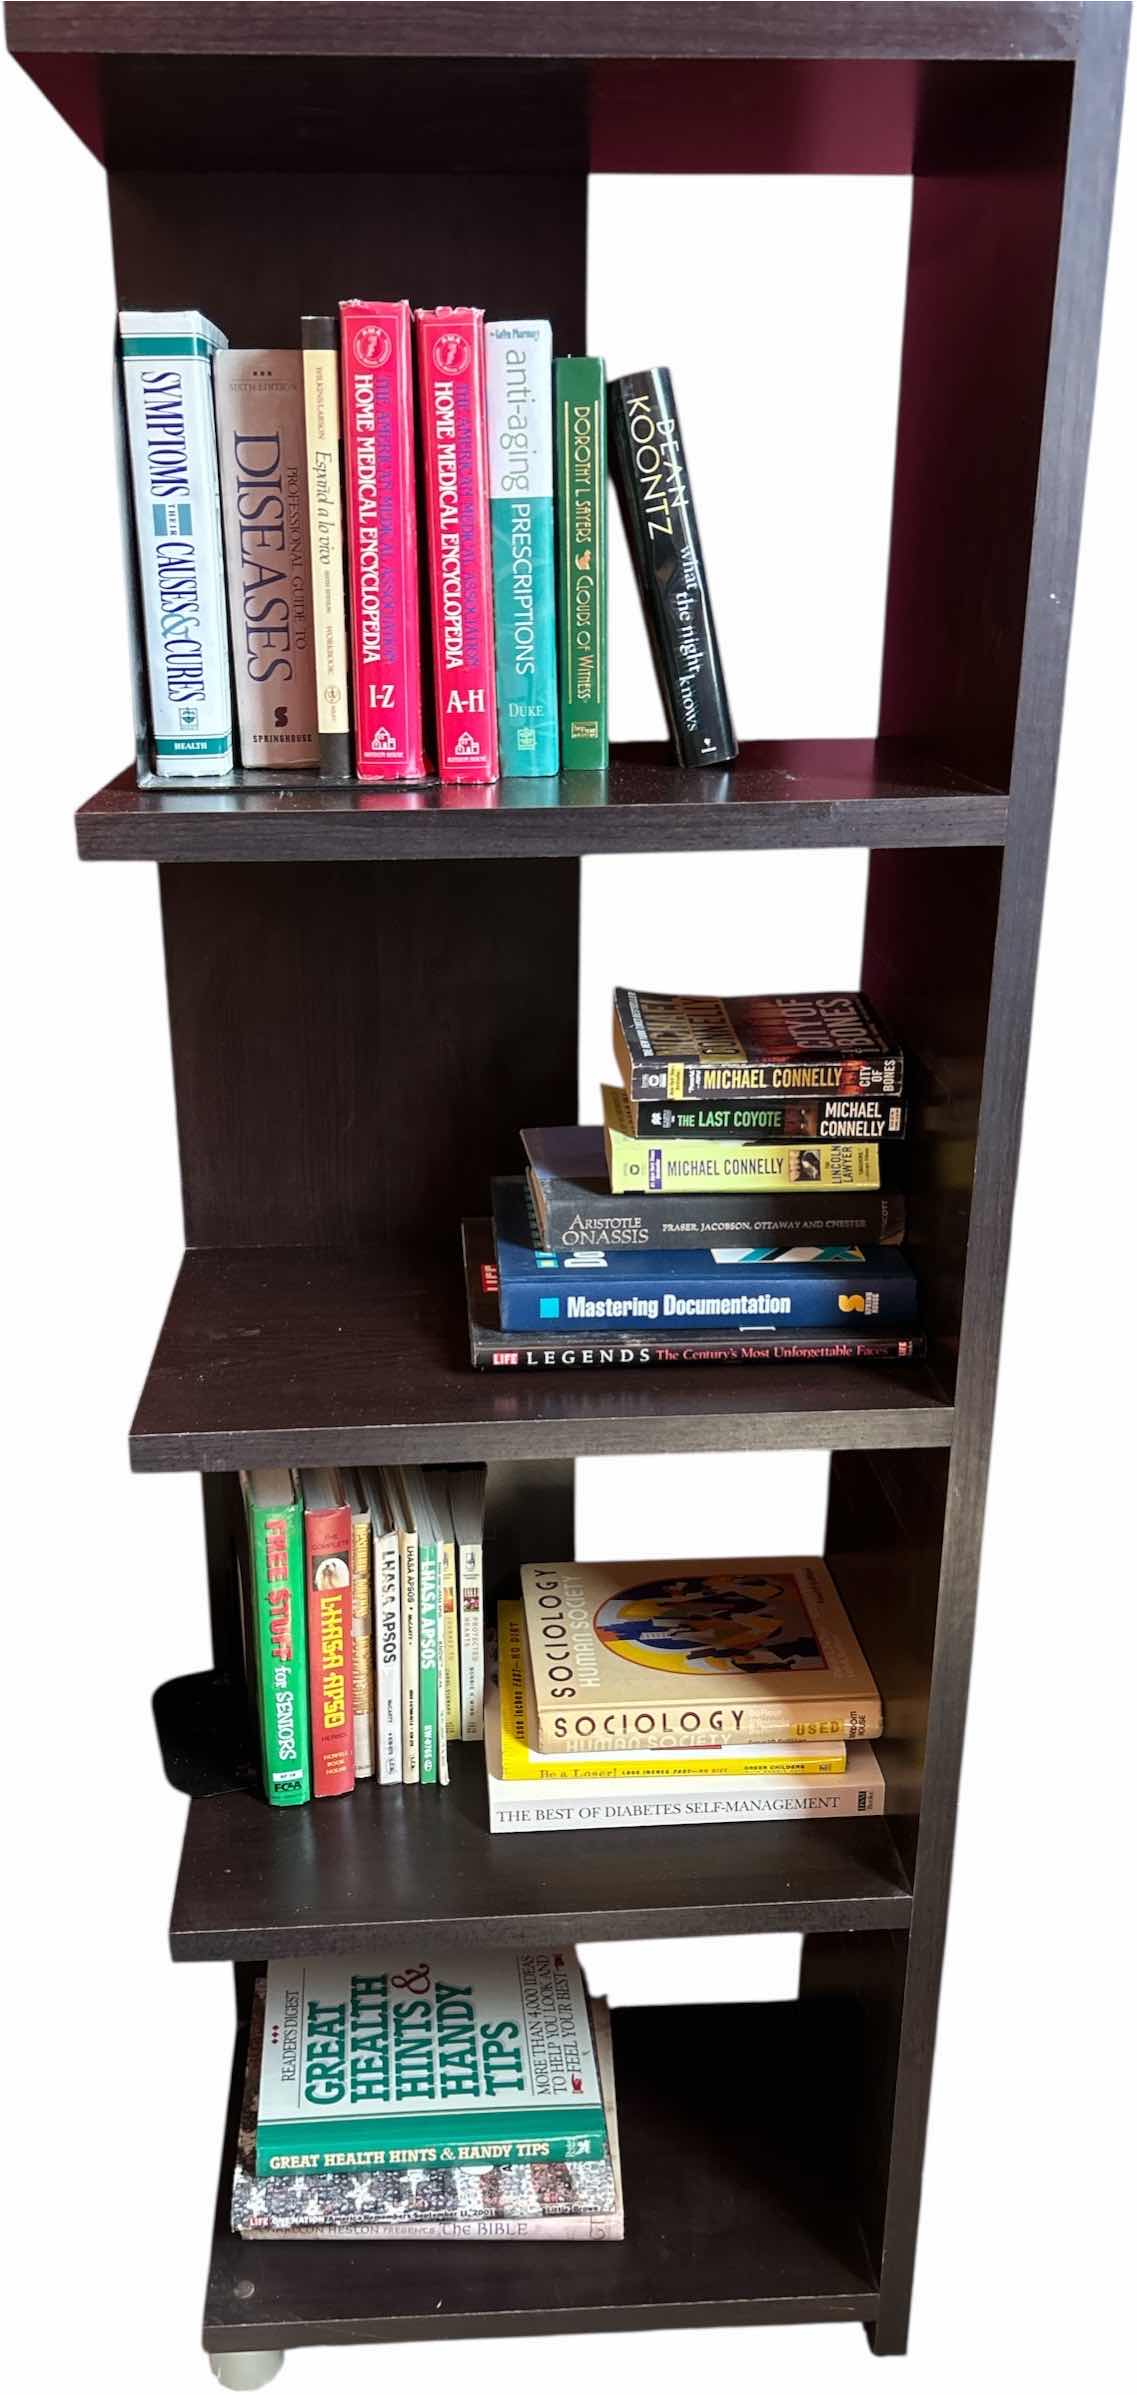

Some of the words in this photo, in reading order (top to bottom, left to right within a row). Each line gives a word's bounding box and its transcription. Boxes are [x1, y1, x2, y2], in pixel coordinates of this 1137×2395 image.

[354, 373, 376, 432] HOME
[434, 381, 456, 439] HOME
[499, 350, 537, 492] anti-aging
[140, 371, 191, 498] SYMPTOMS
[167, 503, 178, 537] THEIR
[575, 406, 591, 484] DOROTHY
[312, 450, 335, 504] Español
[356, 436, 379, 525] MEDICAL
[626, 394, 674, 541] KOONTZ
[656, 418, 691, 510] DEAN
[437, 443, 460, 530] MEDICAL
[286, 466, 304, 569] PROFESSIONAL
[317, 507, 330, 517] a
[317, 520, 336, 534] lo
[575, 500, 592, 544] SAYERS
[233, 431, 294, 683] DISEASES
[318, 536, 336, 565] vivo
[680, 545, 700, 590] what
[291, 576, 308, 624] GUIDE
[359, 526, 381, 665] ENCYCLOPEDIA
[440, 533, 464, 670] ENCYCLOPEDIA
[510, 503, 536, 676] PRESCRIPTIONS
[675, 591, 695, 622] the
[295, 631, 309, 652] TO
[678, 624, 706, 675] night
[368, 684, 396, 708] I-Z
[446, 688, 486, 714] A-H
[678, 674, 698, 732] knows
[784, 1017, 835, 1050] CITY
[815, 998, 874, 1047] BONES
[703, 1068, 768, 1090] MICHAEL
[771, 1067, 843, 1088] CONNELLY
[858, 1066, 872, 1088] CITY
[871, 1070, 882, 1083] OF
[882, 1059, 896, 1092] BONES
[677, 1114, 696, 1128] THE
[698, 1111, 731, 1128] LAST
[733, 1110, 782, 1128] COYOTE
[824, 1101, 882, 1119] MICHAEL
[820, 1119, 886, 1138] CONNELLY
[667, 1159, 721, 1177] MICHAEL
[723, 1157, 785, 1176] CONNELLY
[831, 1144, 842, 1185] LINCOLN
[842, 1146, 854, 1184] LAWYER
[561, 1228, 650, 1246] ONASSIS
[568, 1213, 643, 1230] ARISTOTLE
[754, 1220, 800, 1231] OTTAWAY
[802, 1219, 824, 1230] AND
[567, 1296, 659, 1319] Mastering
[663, 1293, 791, 1318] Documentation
[492, 1352, 519, 1366] LIFE
[526, 1348, 652, 1366] LEGENDS
[655, 1349, 682, 1361] The
[682, 1345, 738, 1361] Century's
[740, 1347, 770, 1359] Most
[773, 1344, 853, 1360] Unforgettable
[265, 1518, 290, 1583] FREE
[407, 1545, 415, 1575] LHASA
[380, 1549, 397, 1607] LHASA
[407, 1576, 416, 1604] APSOS
[420, 1560, 438, 1613] LHASA
[562, 1574, 593, 1631] SOCIETY
[319, 1593, 345, 1669] LHASA
[382, 1611, 398, 1665] APSOS
[420, 1614, 438, 1670] APSOS
[509, 1621, 520, 1644] DIET
[533, 1568, 577, 1699] SOCIOLOGY
[274, 1664, 292, 1689] for
[322, 1671, 346, 1729] APSO
[276, 1691, 297, 1760] SENIORS
[554, 1710, 745, 1738] SOCIOLOGY
[796, 1720, 840, 1736] USED
[496, 1809, 531, 1823] THE
[535, 1807, 573, 1821] BEST
[578, 1805, 602, 1819] OF
[605, 1802, 682, 1818] DIABETES
[685, 1795, 841, 1815] SELF-MANAGEMENT
[390, 1963, 431, 1995] &
[534, 1954, 552, 1978] AND
[537, 1982, 557, 2012] LOOK
[552, 1972, 571, 2001] BEST
[284, 1990, 300, 2028] DIGEST
[541, 2014, 560, 2039] YOU
[556, 2003, 577, 2038] YOUR
[304, 2001, 347, 2106] GREAT
[350, 1973, 390, 2104] HEALTH
[393, 2001, 435, 2102] HINTS
[434, 1981, 480, 2099] HANDY
[529, 2022, 547, 2058] THAN
[562, 2040, 582, 2073] FEEL
[479, 2021, 525, 2097] TIPS
[545, 2041, 565, 2073] HELP
[533, 2059, 552, 2096] MORE
[549, 2075, 568, 2096] TO
[270, 2153, 320, 2170] GREAT
[323, 2150, 386, 2167] HEALTH
[388, 2147, 438, 2164] HINTS
[439, 2147, 456, 2161] &
[457, 2144, 513, 2161] HANDY
[515, 2142, 550, 2158] TIPS
[440, 2222, 473, 2236] The
[477, 2221, 529, 2236] BIBLE
